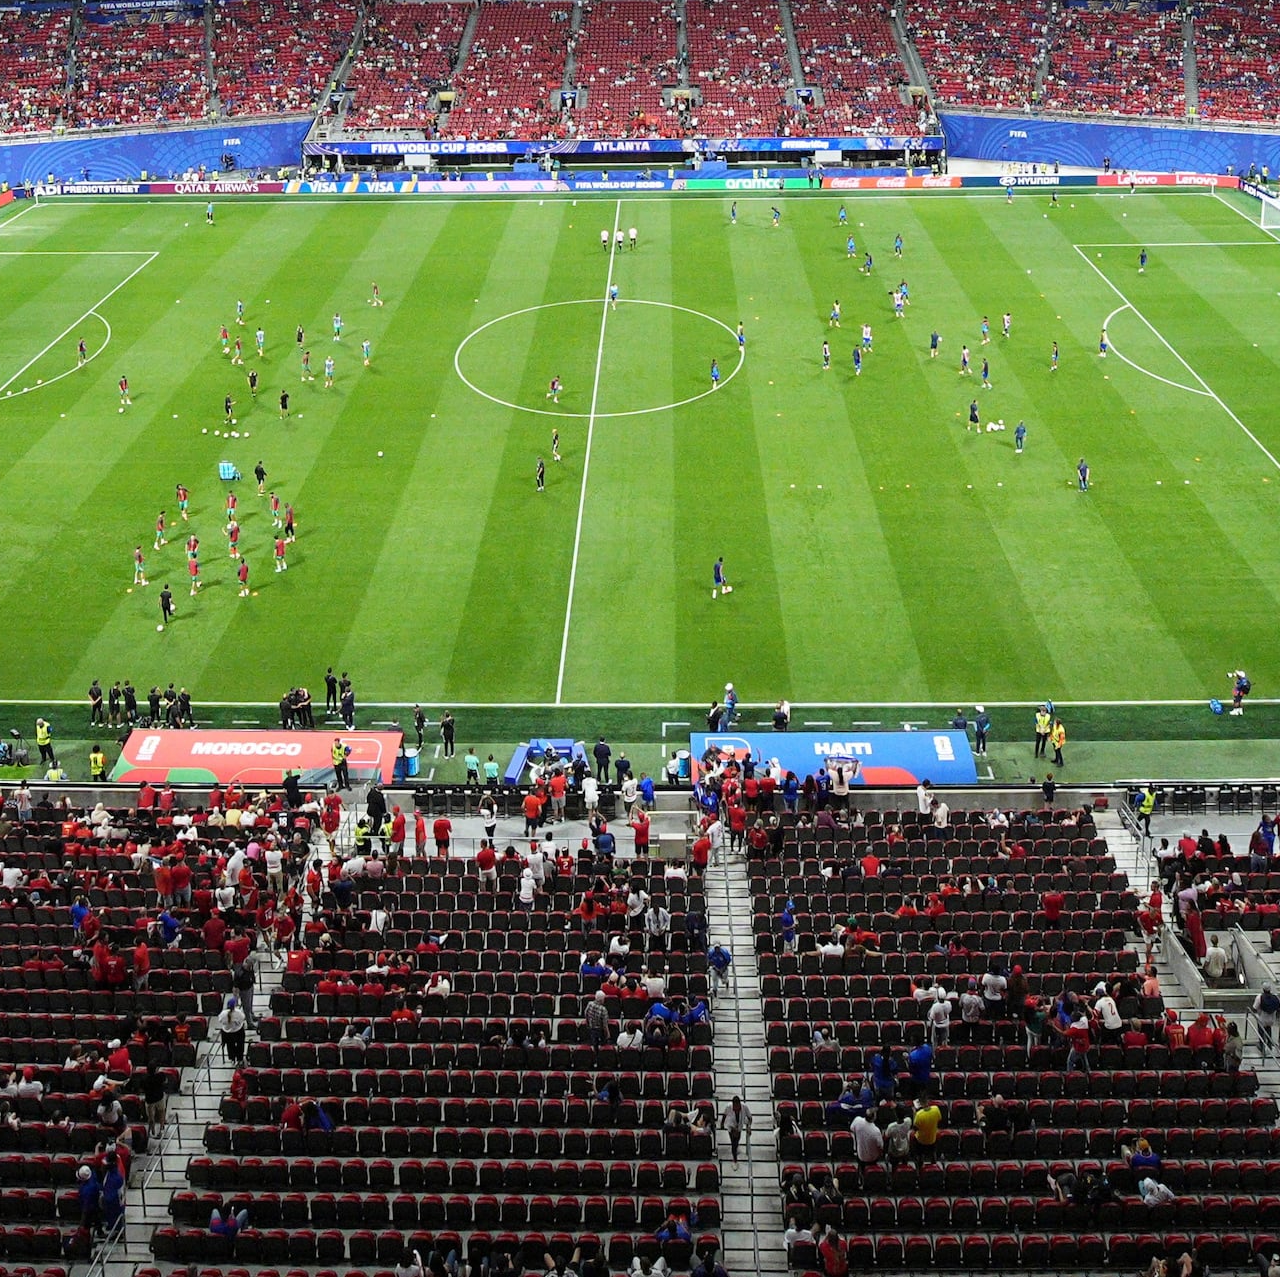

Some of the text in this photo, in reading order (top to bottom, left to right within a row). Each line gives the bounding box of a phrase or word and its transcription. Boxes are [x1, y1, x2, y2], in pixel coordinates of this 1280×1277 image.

[1009, 130, 1027, 138] FIFA
[223, 138, 241, 146] FIFA
[592, 141, 651, 152] ATLANTA
[371, 143, 508, 154] FIFA WORLD CUP 2026
[725, 178, 783, 189] aramco
[830, 177, 859, 188] Coca-Cola
[876, 177, 906, 188] Coca-Cola
[922, 176, 952, 187] Coca-Cola
[1018, 177, 1060, 185] HYUNDAI
[1175, 175, 1218, 186] Lenovo
[33, 184, 61, 196] ADI
[175, 182, 259, 193] QATAR AIRWAYS
[309, 182, 338, 193] VISA
[367, 182, 395, 193] VISA
[191, 742, 302, 756] MOROCCO
[814, 742, 873, 755] HAITI
[278, 815, 288, 826] 18
[563, 862, 569, 870] 2
